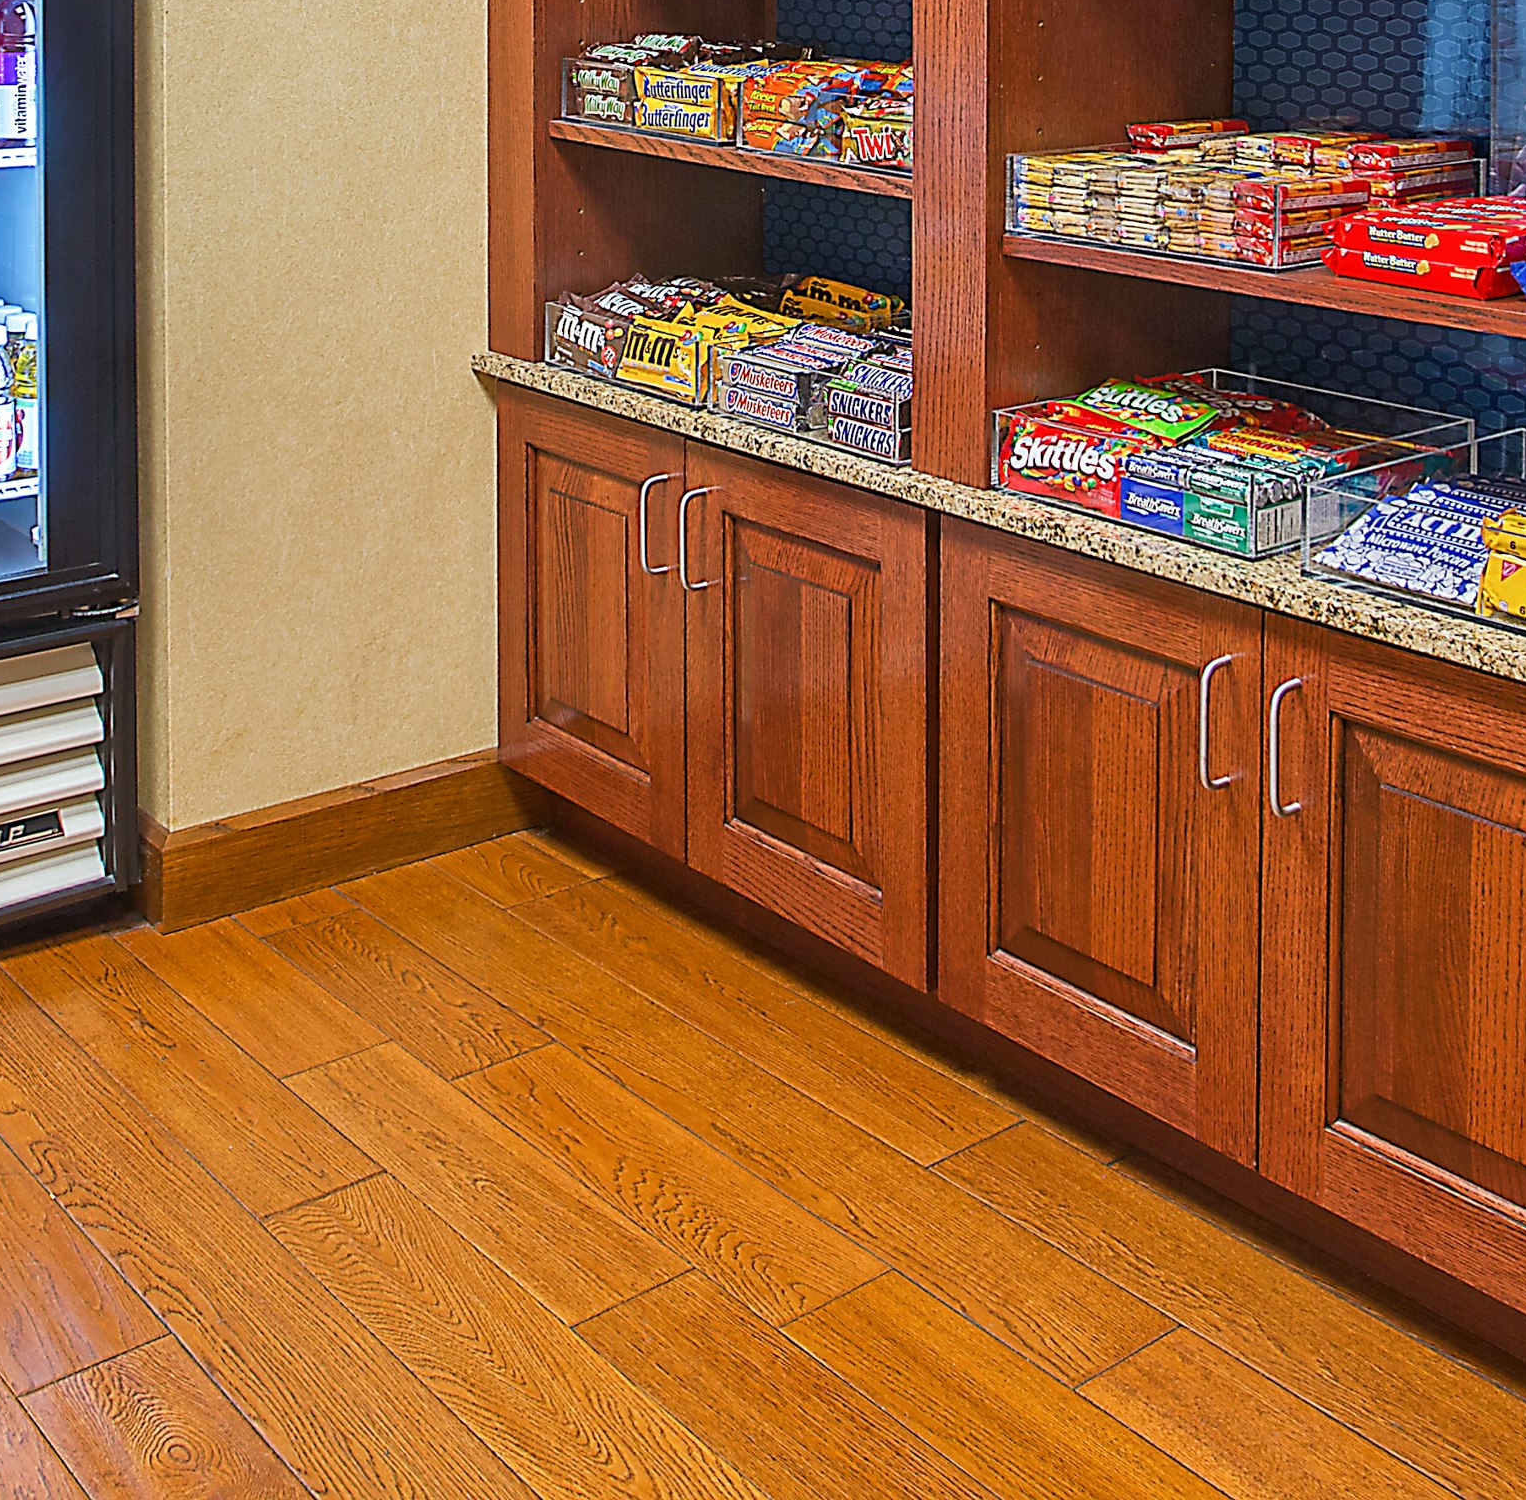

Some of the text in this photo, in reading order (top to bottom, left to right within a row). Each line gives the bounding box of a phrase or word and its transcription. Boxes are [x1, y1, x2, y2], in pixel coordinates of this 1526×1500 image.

[644, 75, 711, 99] Butterfinger
[641, 105, 710, 132] Butterfinger
[1369, 225, 1424, 243] Nutter Butter
[741, 368, 794, 394] Musketeers
[737, 394, 791, 426] Musketeers
[831, 391, 891, 424] SNICKERS
[1087, 388, 1182, 422] Skittles
[834, 419, 894, 453] SNICKERS
[1010, 438, 1115, 479] Skittles
[1403, 512, 1451, 535] ACT
[1367, 532, 1471, 569] Microwave Popcorn
